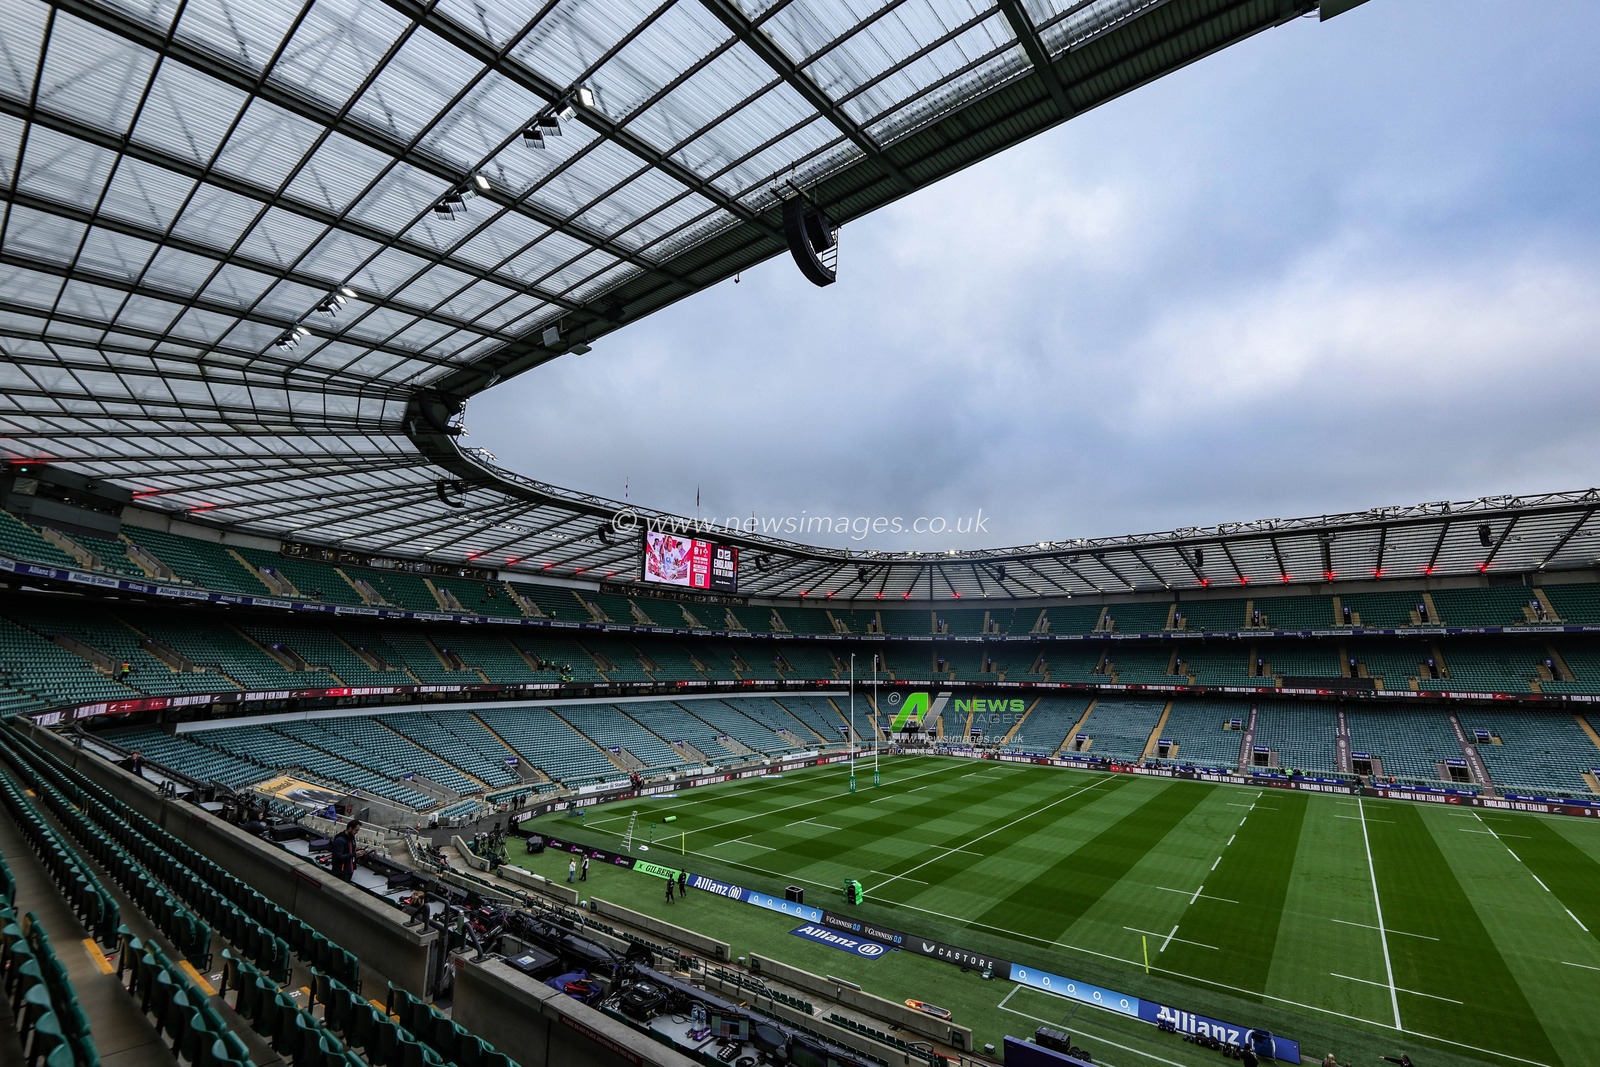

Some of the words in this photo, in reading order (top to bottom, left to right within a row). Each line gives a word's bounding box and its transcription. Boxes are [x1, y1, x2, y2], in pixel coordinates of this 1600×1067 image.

[28, 566, 48, 576] Allianz
[73, 574, 90, 582] Allianz
[97, 578, 115, 586] Stadium
[1470, 757, 1486, 784] Allianz
[1333, 786, 1350, 794] ZEALAND
[1388, 791, 1411, 800] ENGLAND
[1416, 793, 1426, 801] NEW
[1426, 794, 1445, 803] ZEALAND
[1484, 800, 1510, 809] ENGLAND
[1515, 802, 1526, 810] NEW
[1527, 803, 1548, 812] ZEALAND
[646, 865, 676, 880] GILBERT
[694, 876, 727, 896] Allianz
[830, 916, 852, 929] GUINNESS
[798, 925, 858, 948] Allianz
[868, 928, 893, 942] GUINNESS
[938, 948, 993, 969] CASTORE
[1160, 1006, 1240, 1046] Allianz
[586, 1030, 596, 1038] PLACE
